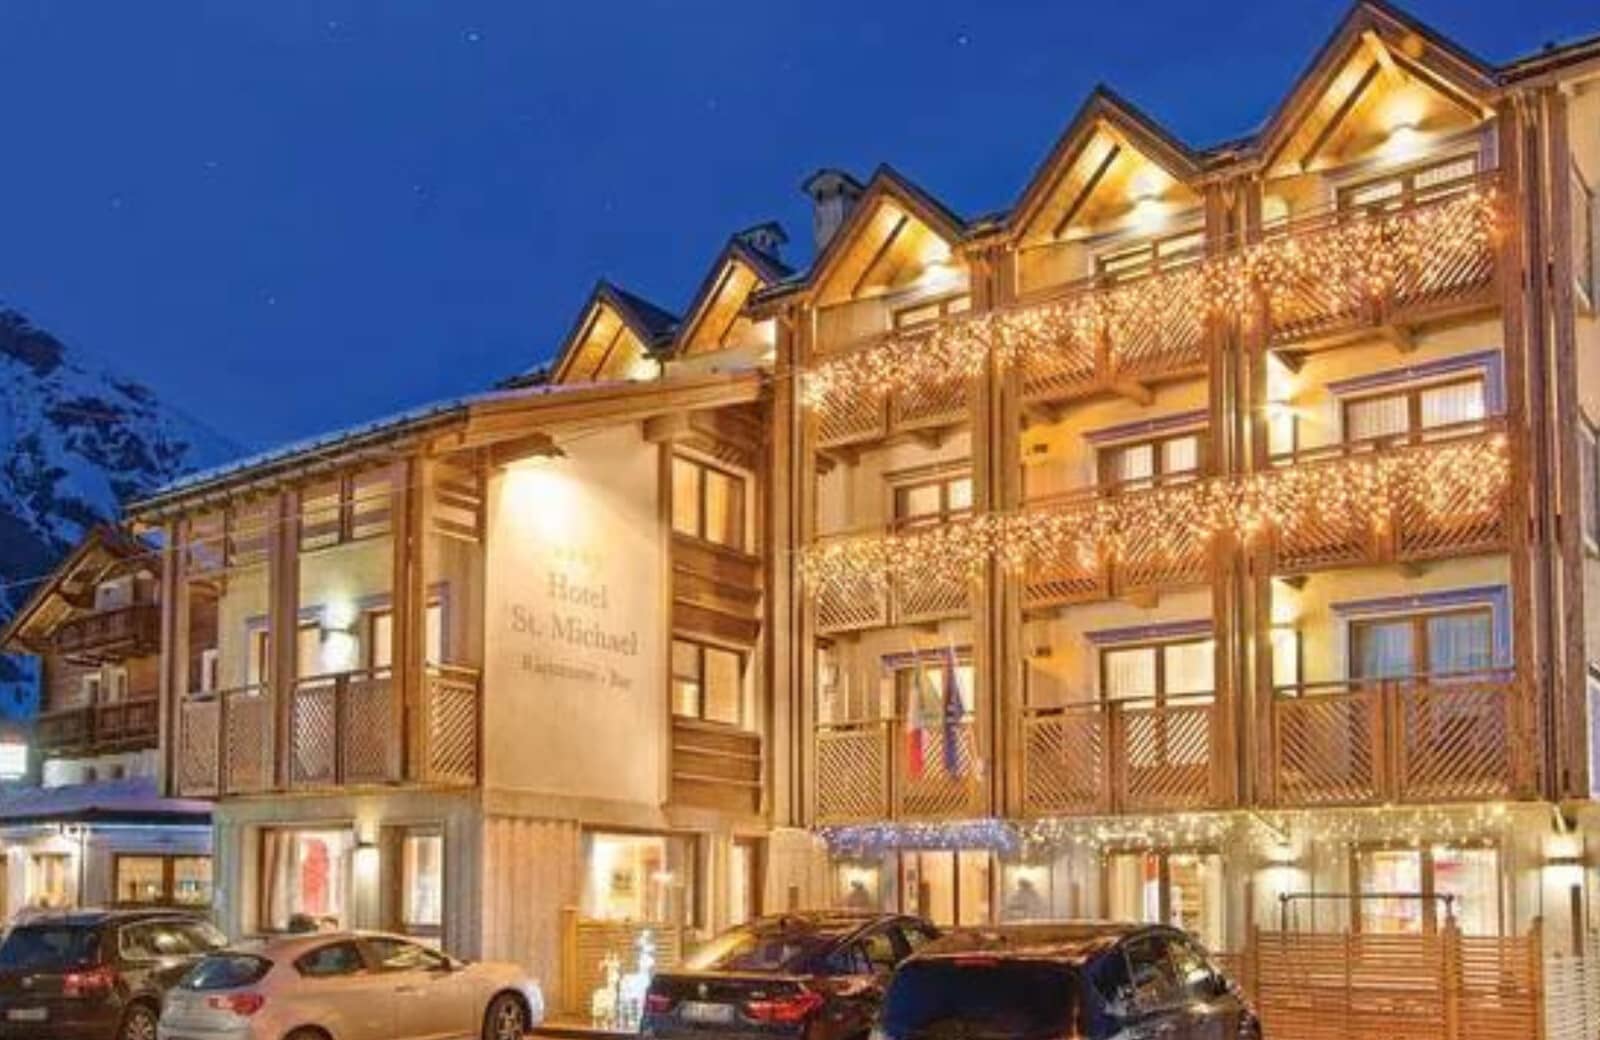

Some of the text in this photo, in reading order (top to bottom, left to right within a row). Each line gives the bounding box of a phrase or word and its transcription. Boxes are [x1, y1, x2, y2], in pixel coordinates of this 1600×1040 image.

[547, 571, 608, 609] Hotel
[510, 604, 639, 656] St. Michael
